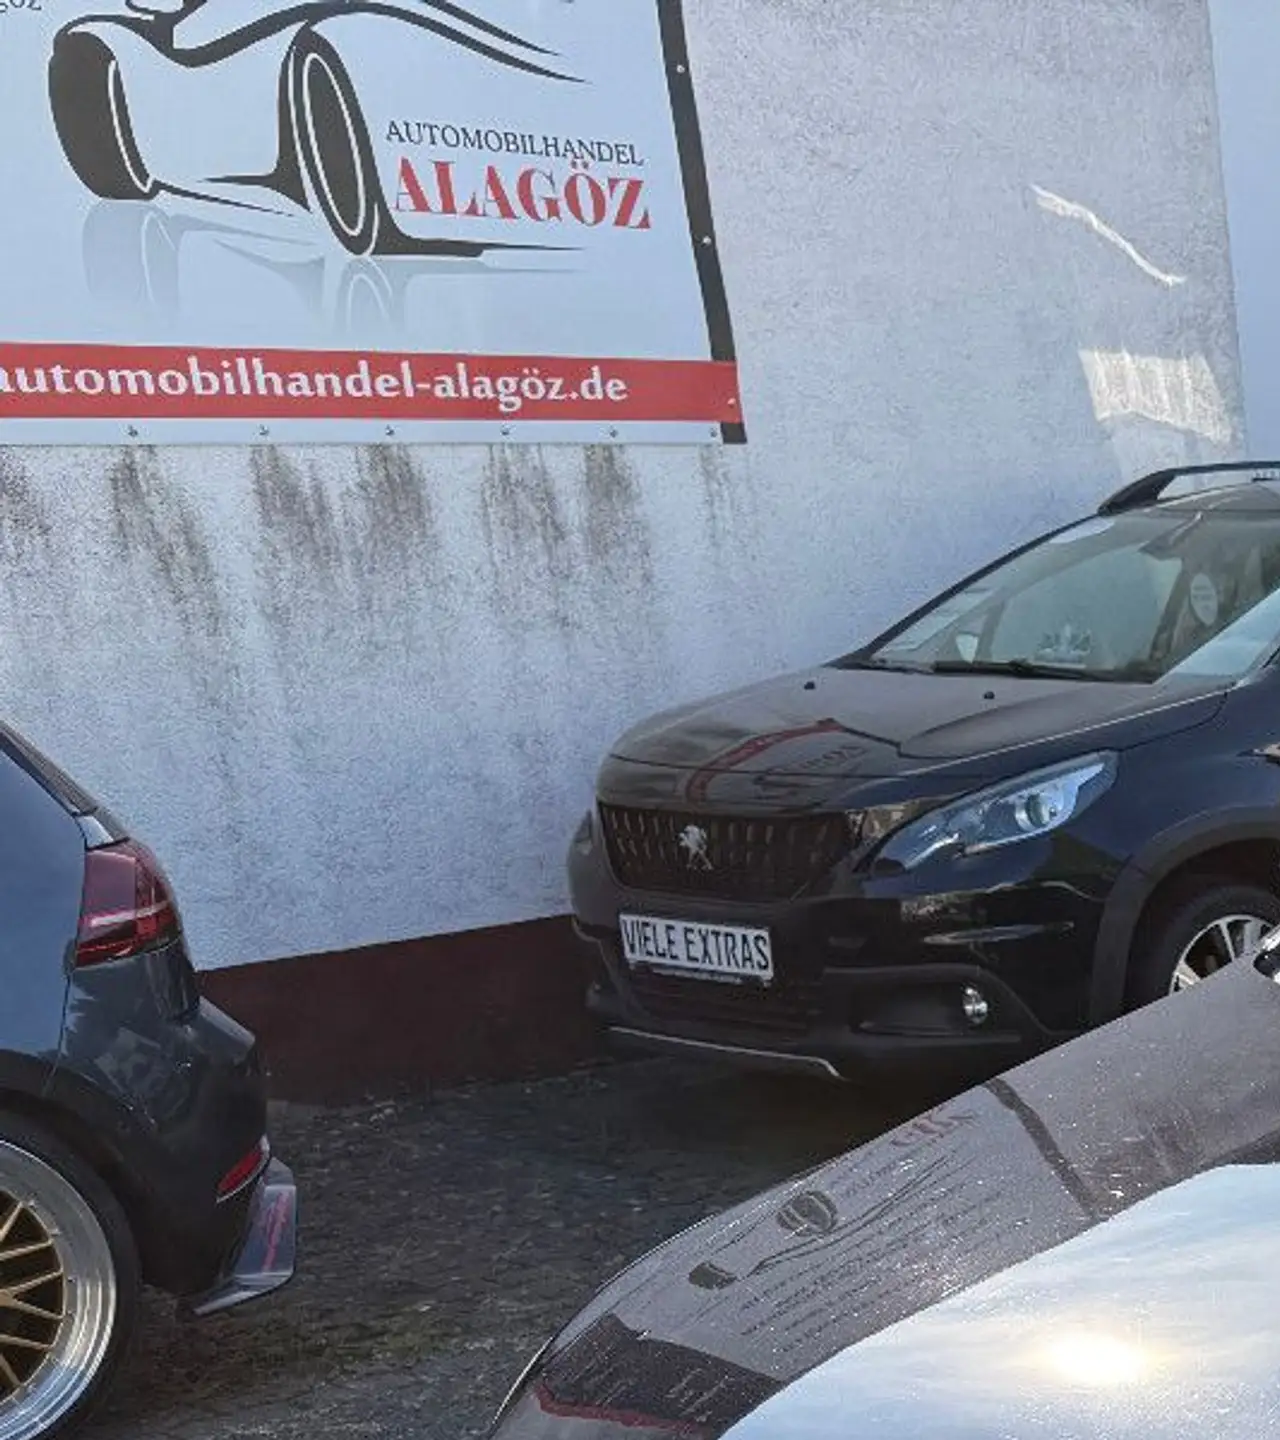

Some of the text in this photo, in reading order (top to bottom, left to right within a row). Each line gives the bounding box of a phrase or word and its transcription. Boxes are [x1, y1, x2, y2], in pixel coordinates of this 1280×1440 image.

[385, 120, 645, 166] AUTOMOBILHANDEL
[391, 156, 651, 229] ALAGÖZ
[622, 919, 770, 971] VIELE EXTRAS
